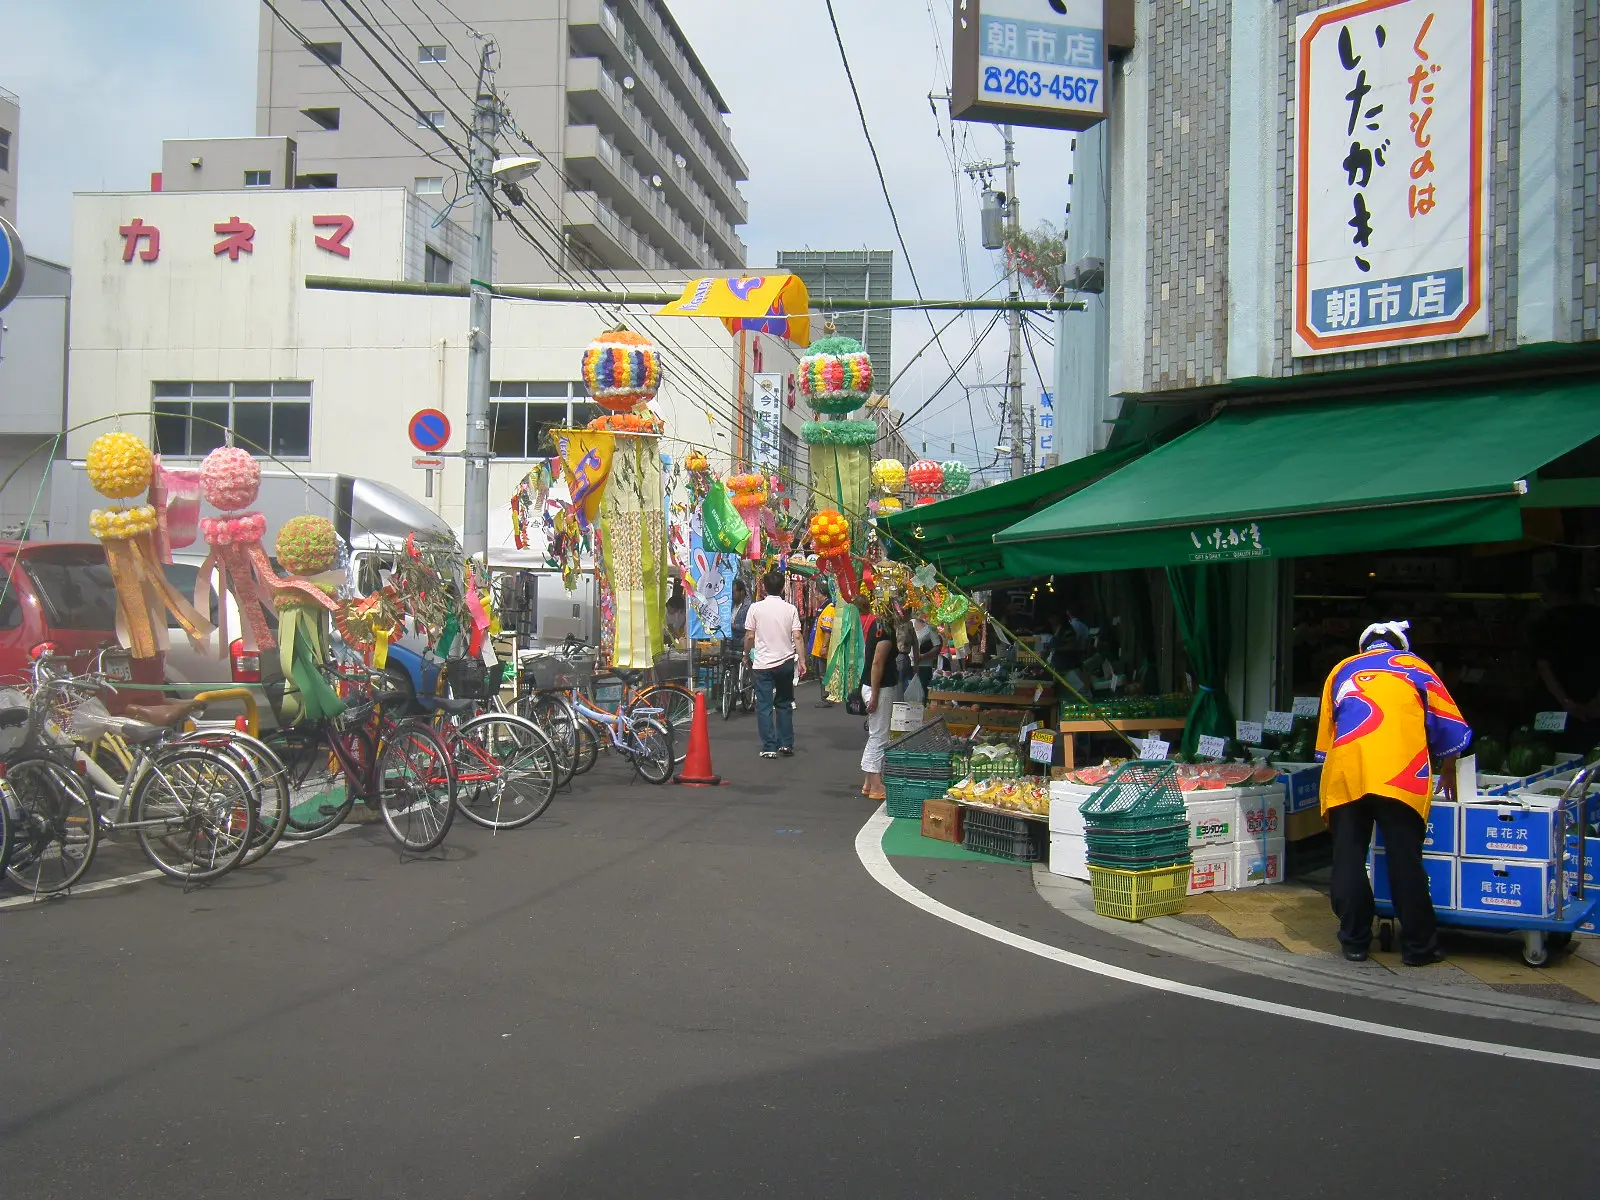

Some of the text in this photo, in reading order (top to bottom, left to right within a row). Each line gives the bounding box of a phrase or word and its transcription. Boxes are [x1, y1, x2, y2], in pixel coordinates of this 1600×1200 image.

[987, 21, 1097, 67] 朝市店
[1004, 69, 1099, 104] 263-4567
[1337, 24, 1392, 273] いたがき
[119, 214, 355, 262] カネマ
[1326, 275, 1447, 329] 朝市店
[1190, 522, 1262, 549] いたがき
[1486, 826, 1528, 840] 尾花沢
[1481, 881, 1521, 896] 尾花沢
